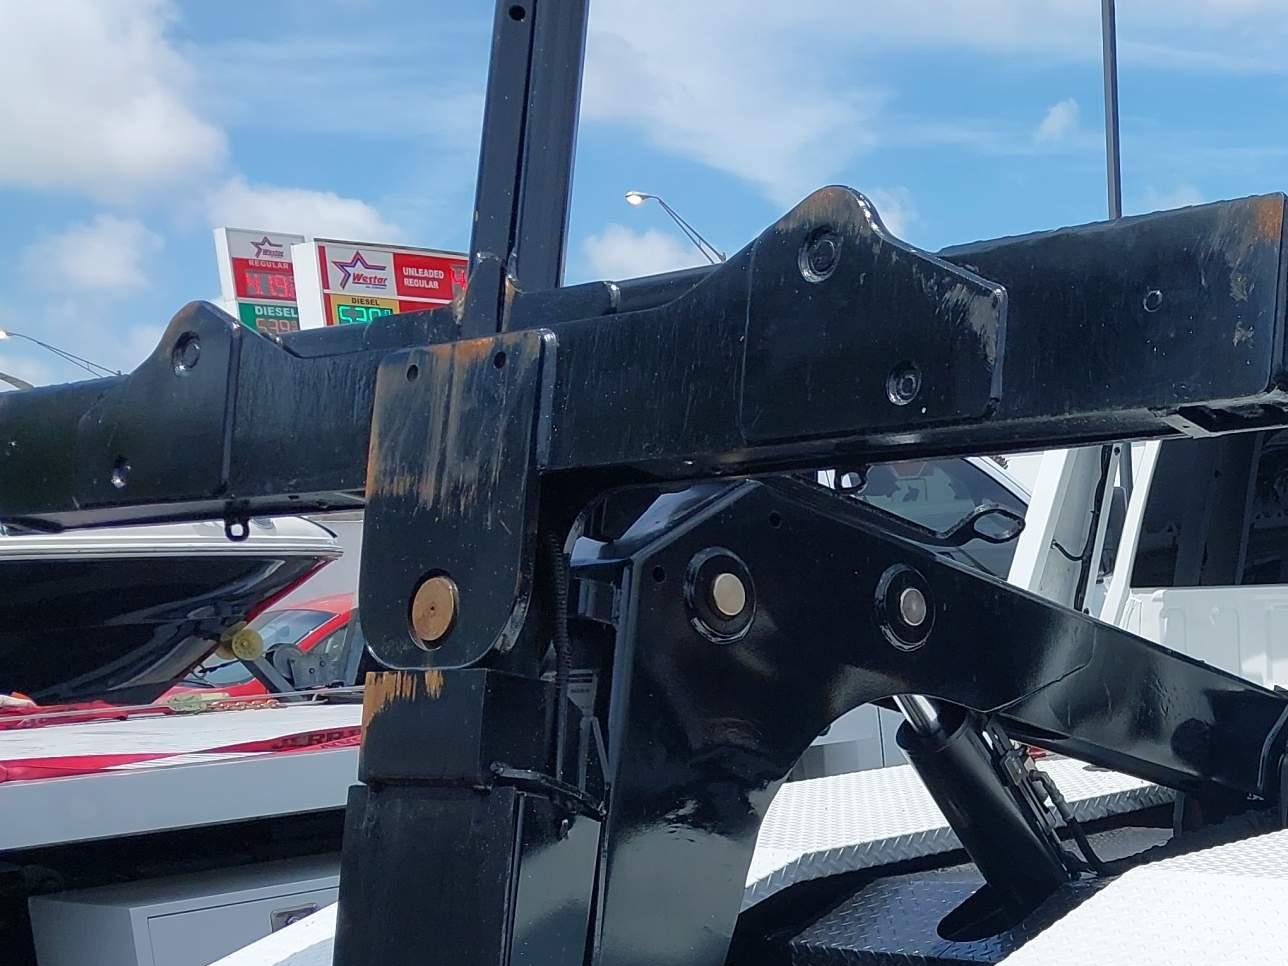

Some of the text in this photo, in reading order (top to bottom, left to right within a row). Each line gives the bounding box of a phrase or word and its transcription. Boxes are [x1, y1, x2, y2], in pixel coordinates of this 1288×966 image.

[248, 259, 289, 270] REGULAR
[402, 266, 445, 280] UNLEADED
[403, 278, 440, 290] REGULAR
[351, 297, 379, 306] DIESEL
[254, 305, 299, 318] DIESEL
